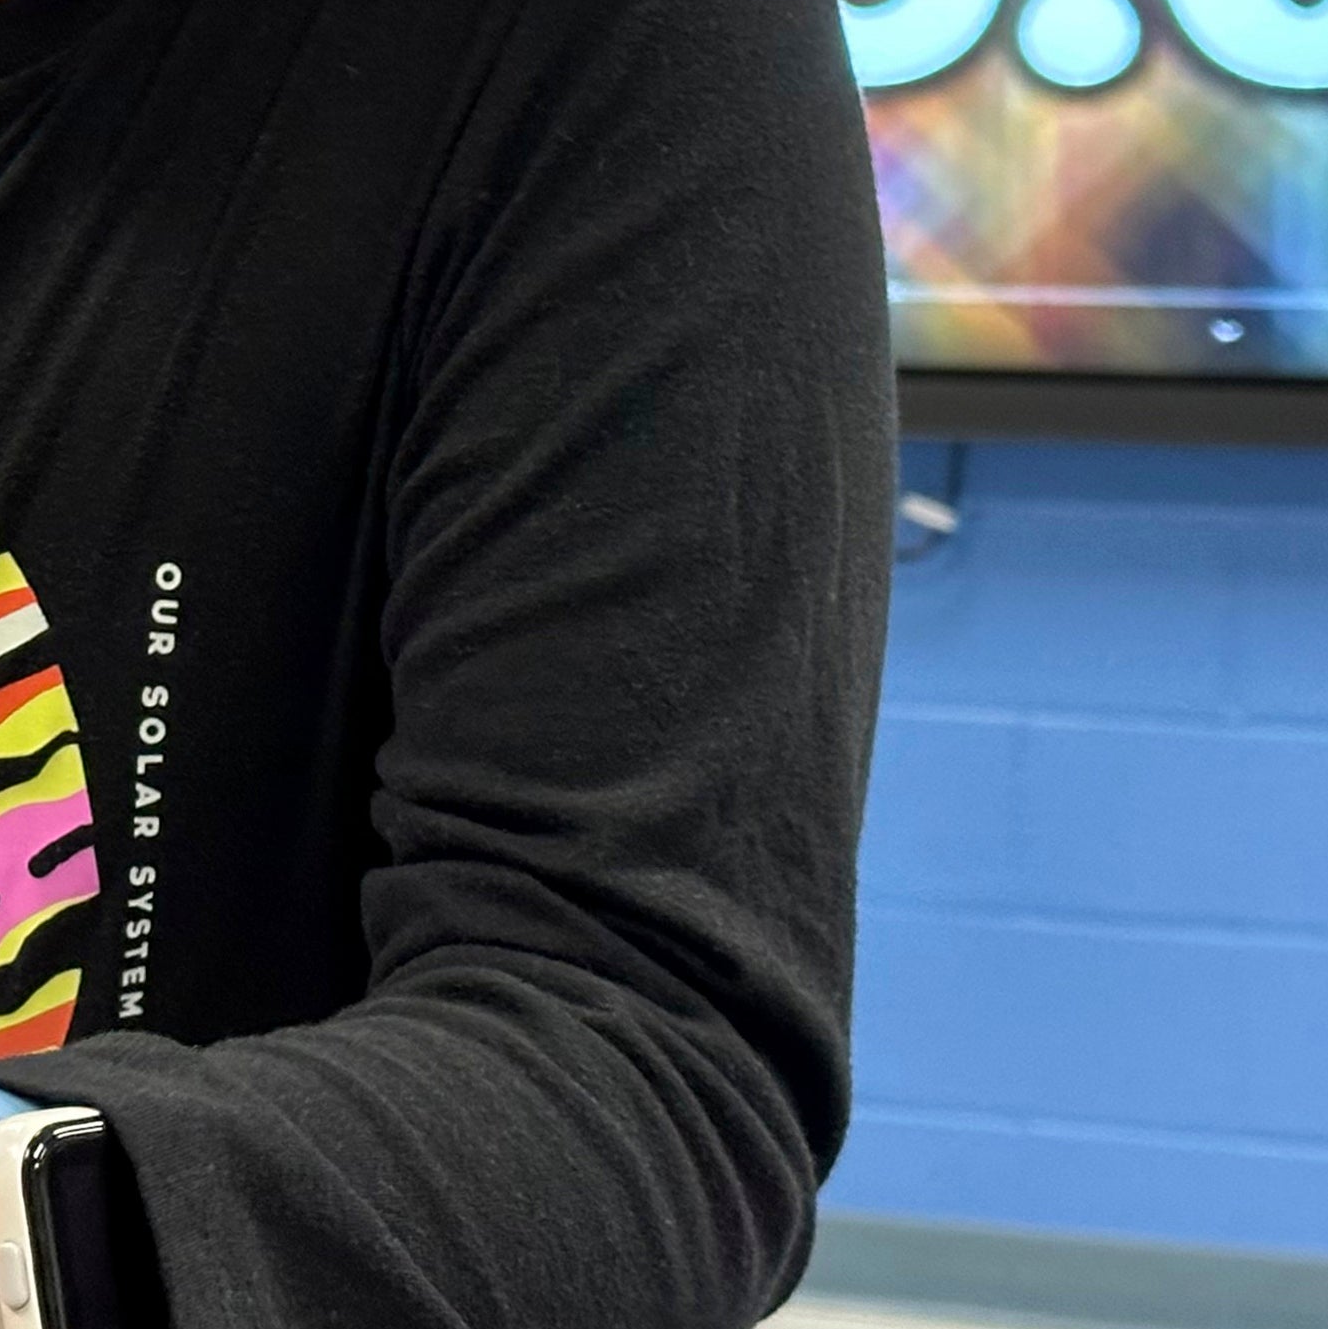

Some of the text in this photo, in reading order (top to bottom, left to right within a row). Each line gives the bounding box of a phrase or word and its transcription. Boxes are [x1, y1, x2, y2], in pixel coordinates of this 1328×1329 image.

[118, 562, 183, 1020] OUR SOLAR SYSTEM
